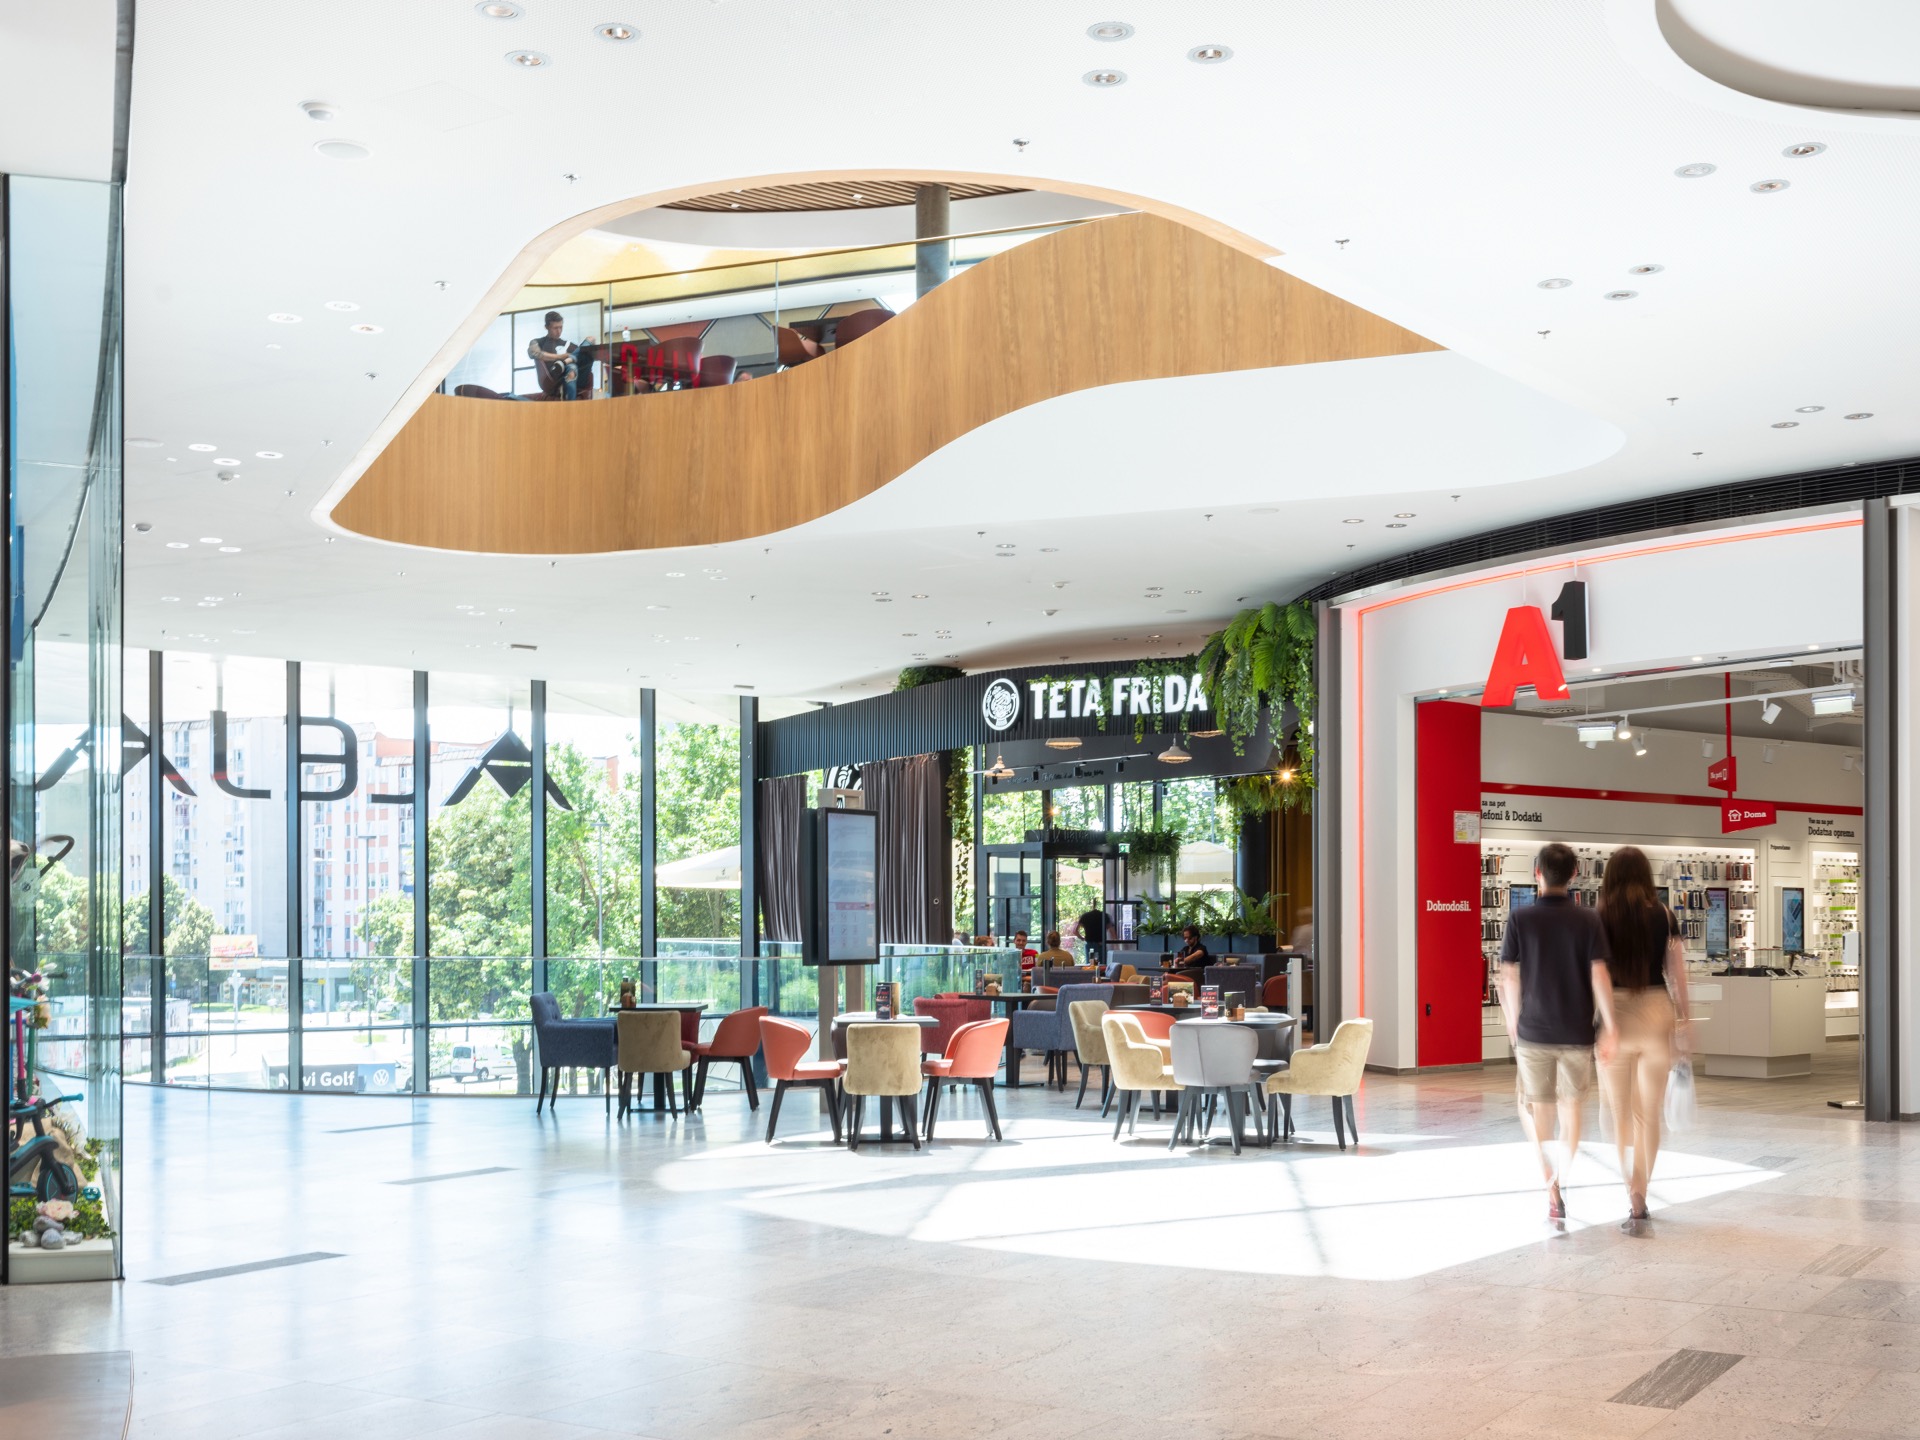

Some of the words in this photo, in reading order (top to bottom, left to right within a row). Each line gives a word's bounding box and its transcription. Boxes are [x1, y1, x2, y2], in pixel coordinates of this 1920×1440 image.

[1481, 580, 1590, 707] A1
[1030, 678, 1105, 720] TETA
[1113, 673, 1208, 716] FRIDA
[1497, 800, 1506, 808] pot
[1481, 809, 1503, 820] lefoni
[1505, 810, 1510, 820] &
[1512, 810, 1542, 822] Dodatki
[1808, 826, 1832, 836] Dodatna
[1833, 830, 1854, 839] oprema
[1426, 899, 1472, 912] Dobrodošli.
[278, 1072, 316, 1087] Nvi
[320, 1071, 355, 1087] Golf
